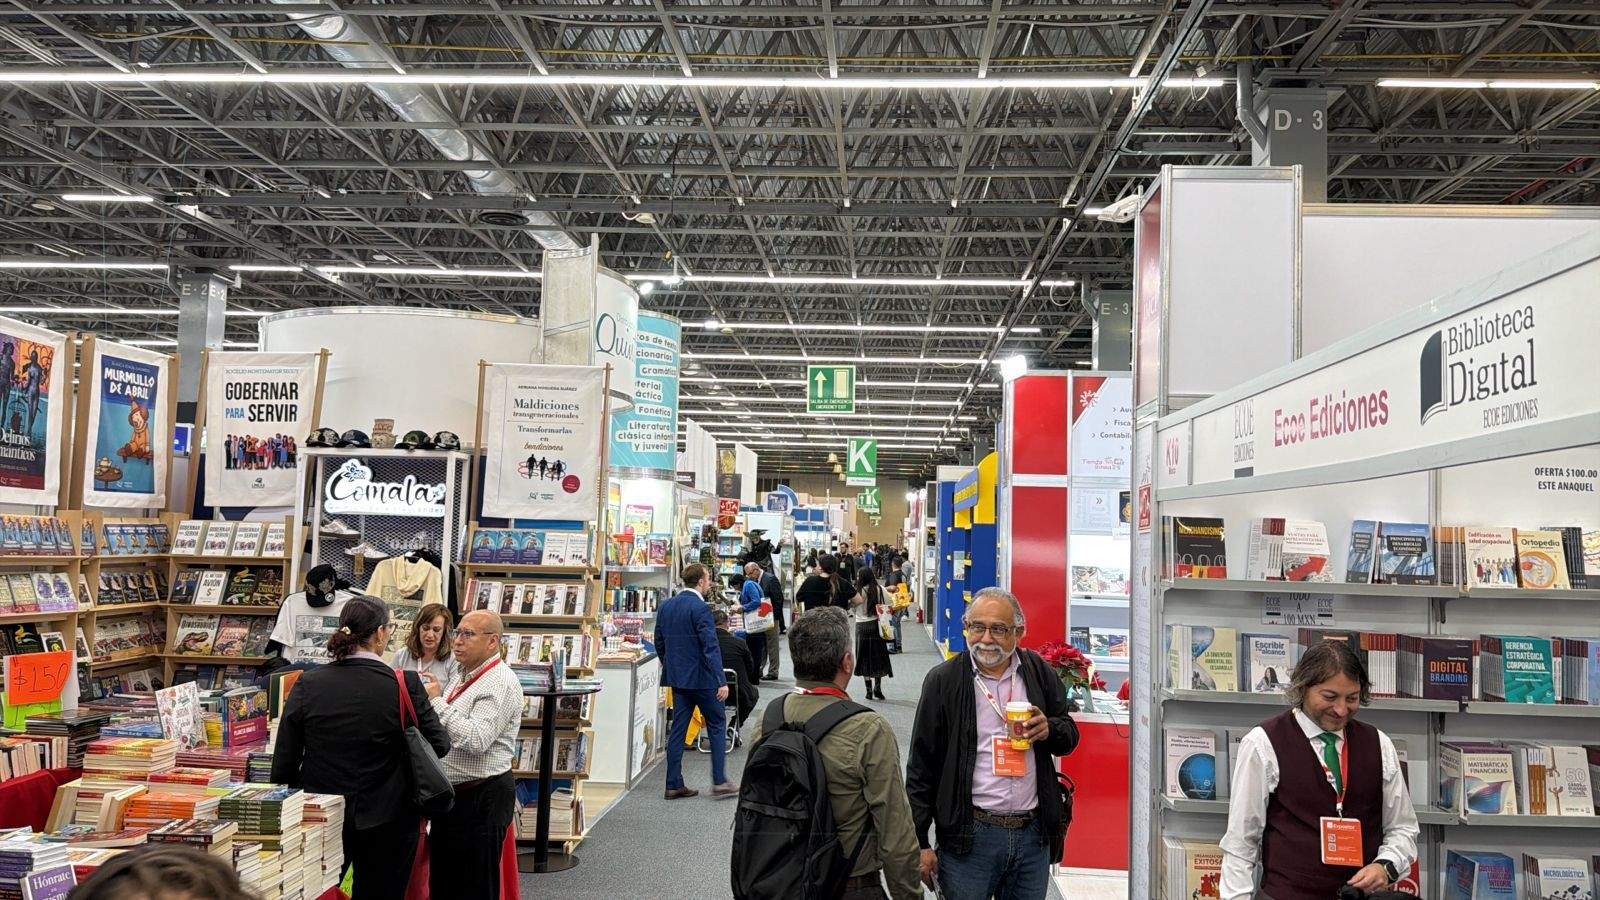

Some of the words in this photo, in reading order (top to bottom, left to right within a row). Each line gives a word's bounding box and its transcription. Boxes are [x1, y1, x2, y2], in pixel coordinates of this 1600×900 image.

[1447, 305, 1535, 356] Biblioteca
[104, 367, 155, 387] MURMULLO
[1449, 338, 1537, 407] Digital
[109, 382, 123, 395] DE
[124, 384, 149, 400] ABRIL
[225, 381, 299, 401] GOBERNAR
[225, 407, 245, 419] PARA
[248, 404, 298, 423] SERVIR
[513, 398, 580, 411] Maldiciones
[1501, 397, 1539, 425] EDICIONES
[1274, 408, 1306, 447] Ecoe
[1309, 389, 1389, 440] Ediciones
[617, 431, 651, 441] clásica
[523, 442, 564, 452] bendiciones
[642, 442, 669, 451] juvenil
[849, 440, 874, 473] K
[1534, 467, 1564, 477] OFERTA
[1565, 468, 1598, 479] $100.00
[330, 470, 432, 505] Comala
[1538, 481, 1556, 490] ESTE
[1557, 482, 1594, 492] ANAQUEL
[1521, 538, 1560, 548] Ortopedia
[1505, 641, 1533, 651] GERENCIA
[1430, 661, 1468, 674] DIGITAL
[13, 662, 70, 695] $150
[1430, 673, 1468, 683] BRANDING
[33, 871, 71, 890] Hónrate
